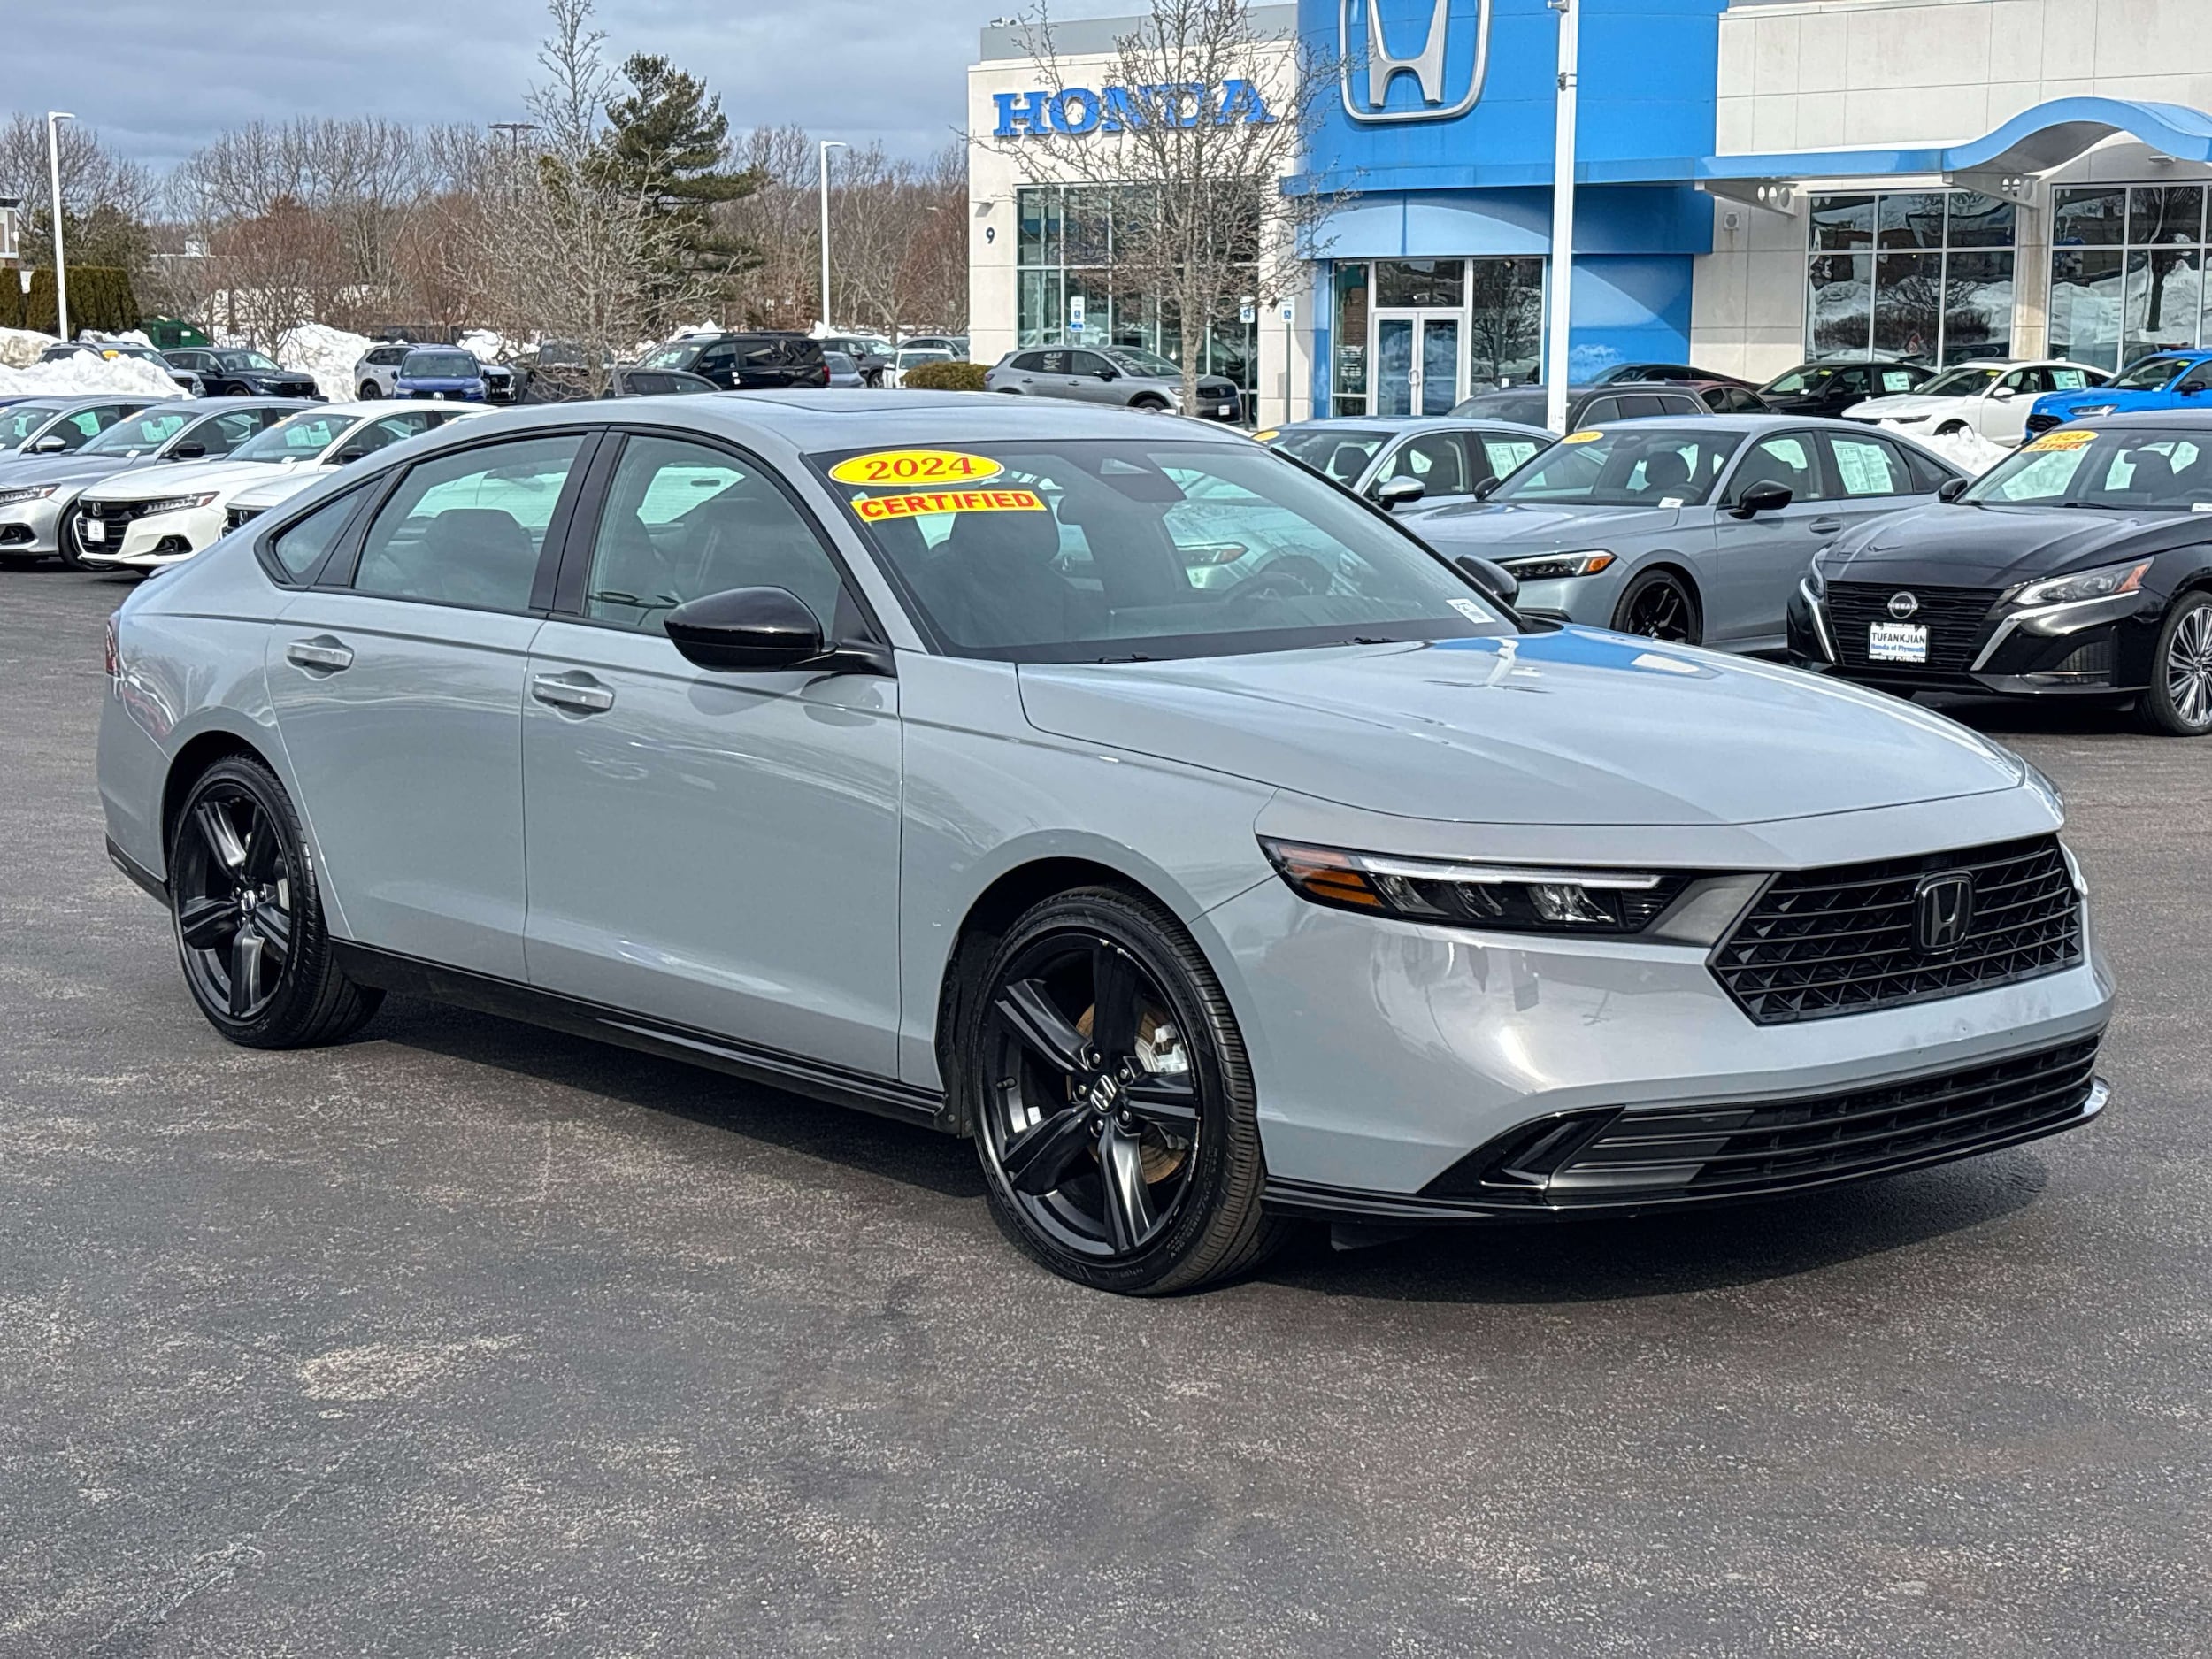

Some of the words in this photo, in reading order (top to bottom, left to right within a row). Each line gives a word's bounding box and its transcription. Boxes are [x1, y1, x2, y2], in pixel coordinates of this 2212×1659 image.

[993, 80, 1279, 137] HONDA
[986, 227, 995, 245] 9
[864, 457, 976, 481] 2024
[860, 493, 1035, 518] CERTIFIED
[1887, 602, 1919, 611] NISSAN
[1872, 633, 1925, 644] TUFANKJIAN
